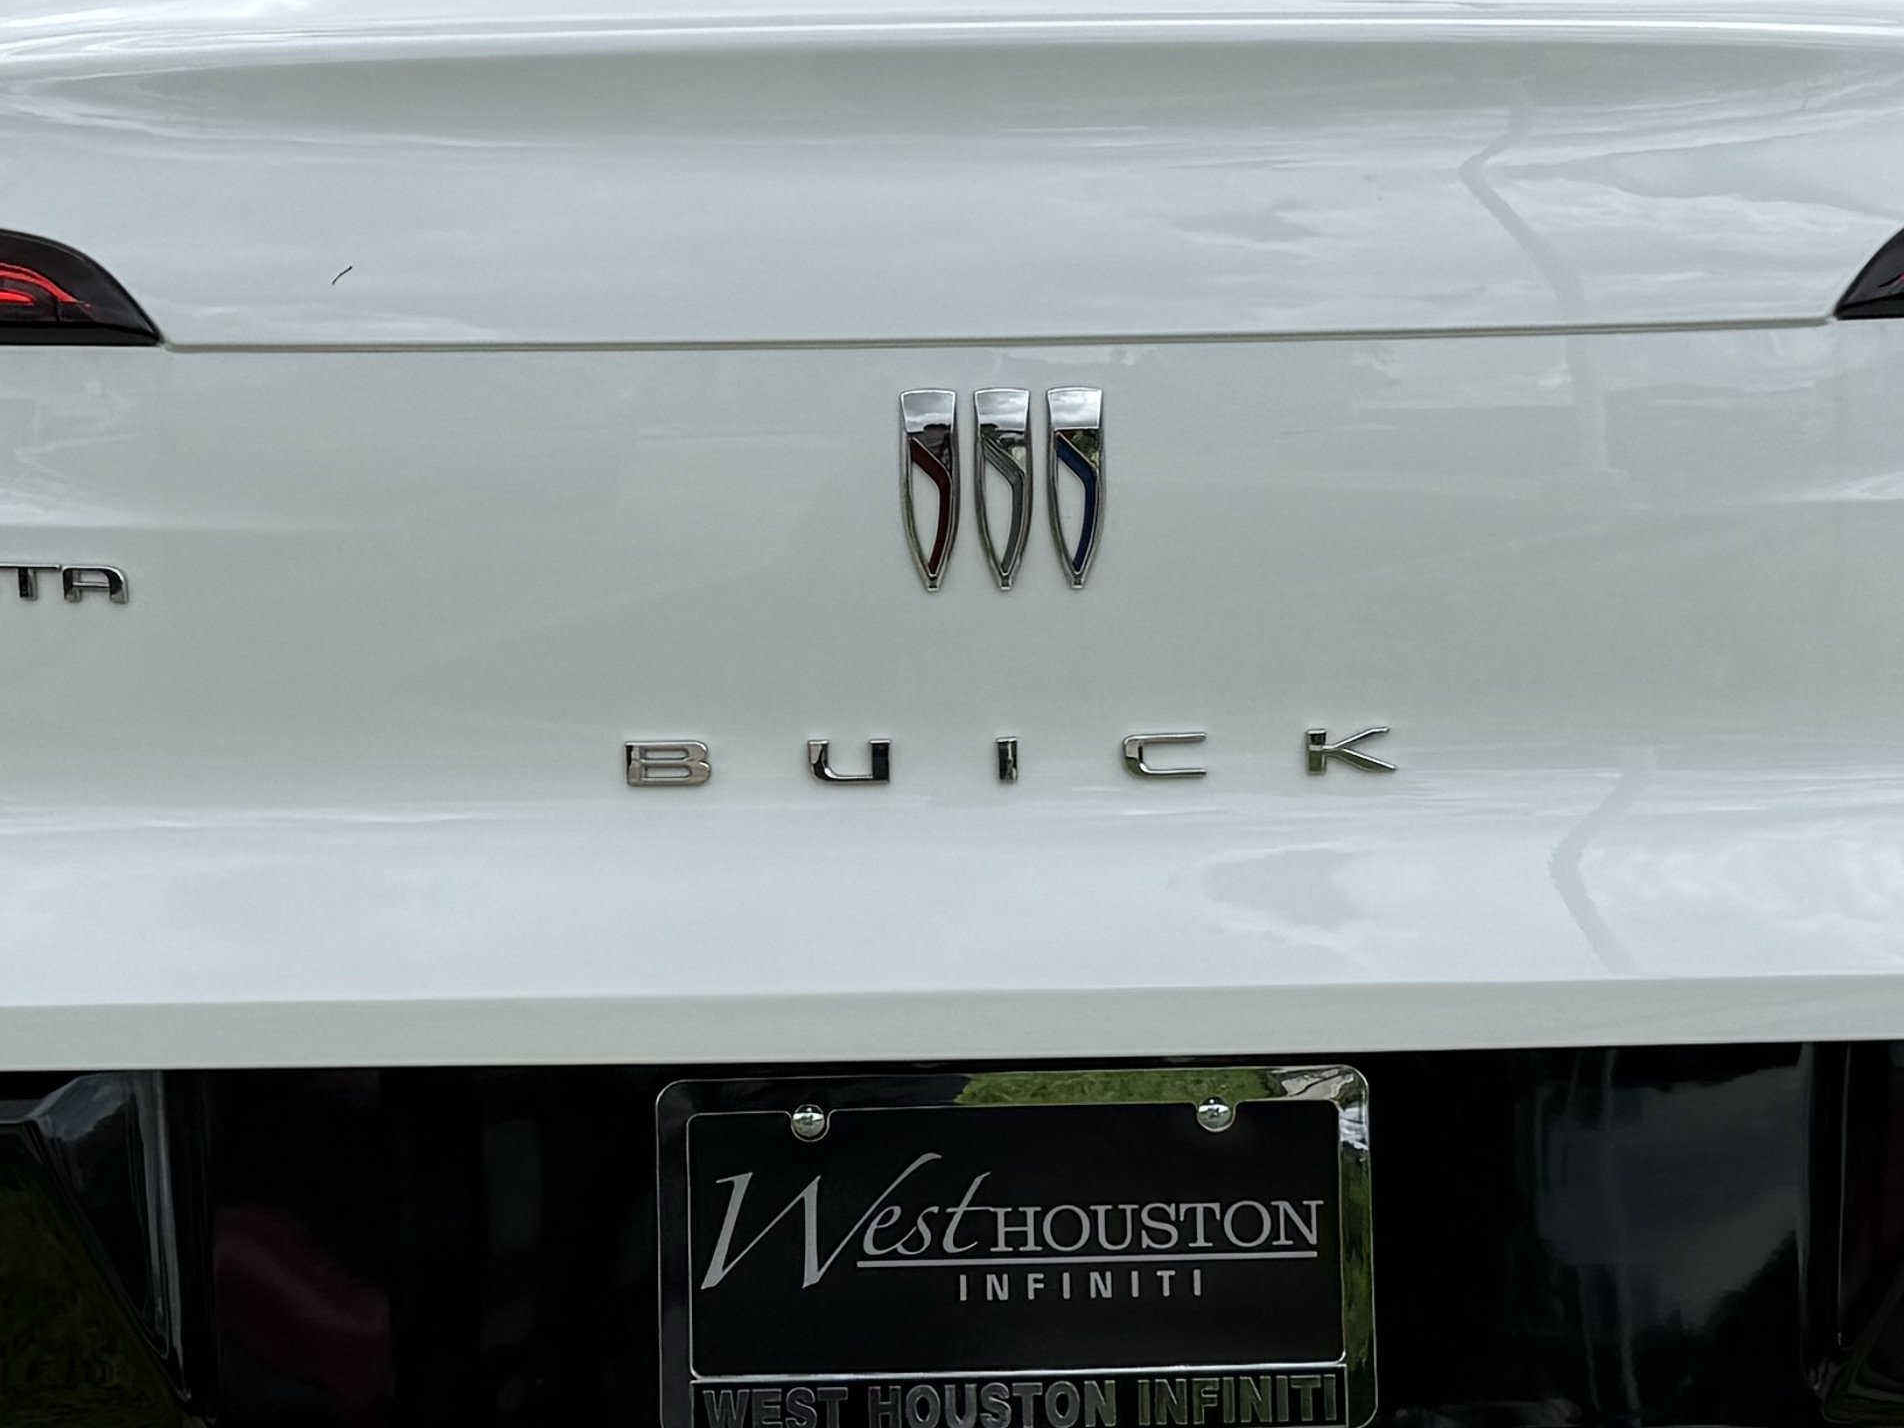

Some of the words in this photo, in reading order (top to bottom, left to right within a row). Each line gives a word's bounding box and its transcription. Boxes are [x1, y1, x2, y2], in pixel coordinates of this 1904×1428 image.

[625, 725, 1398, 787] BUICK
[959, 1268, 1203, 1301] INFINITI
[1136, 1373, 1337, 1426] INFINITI
